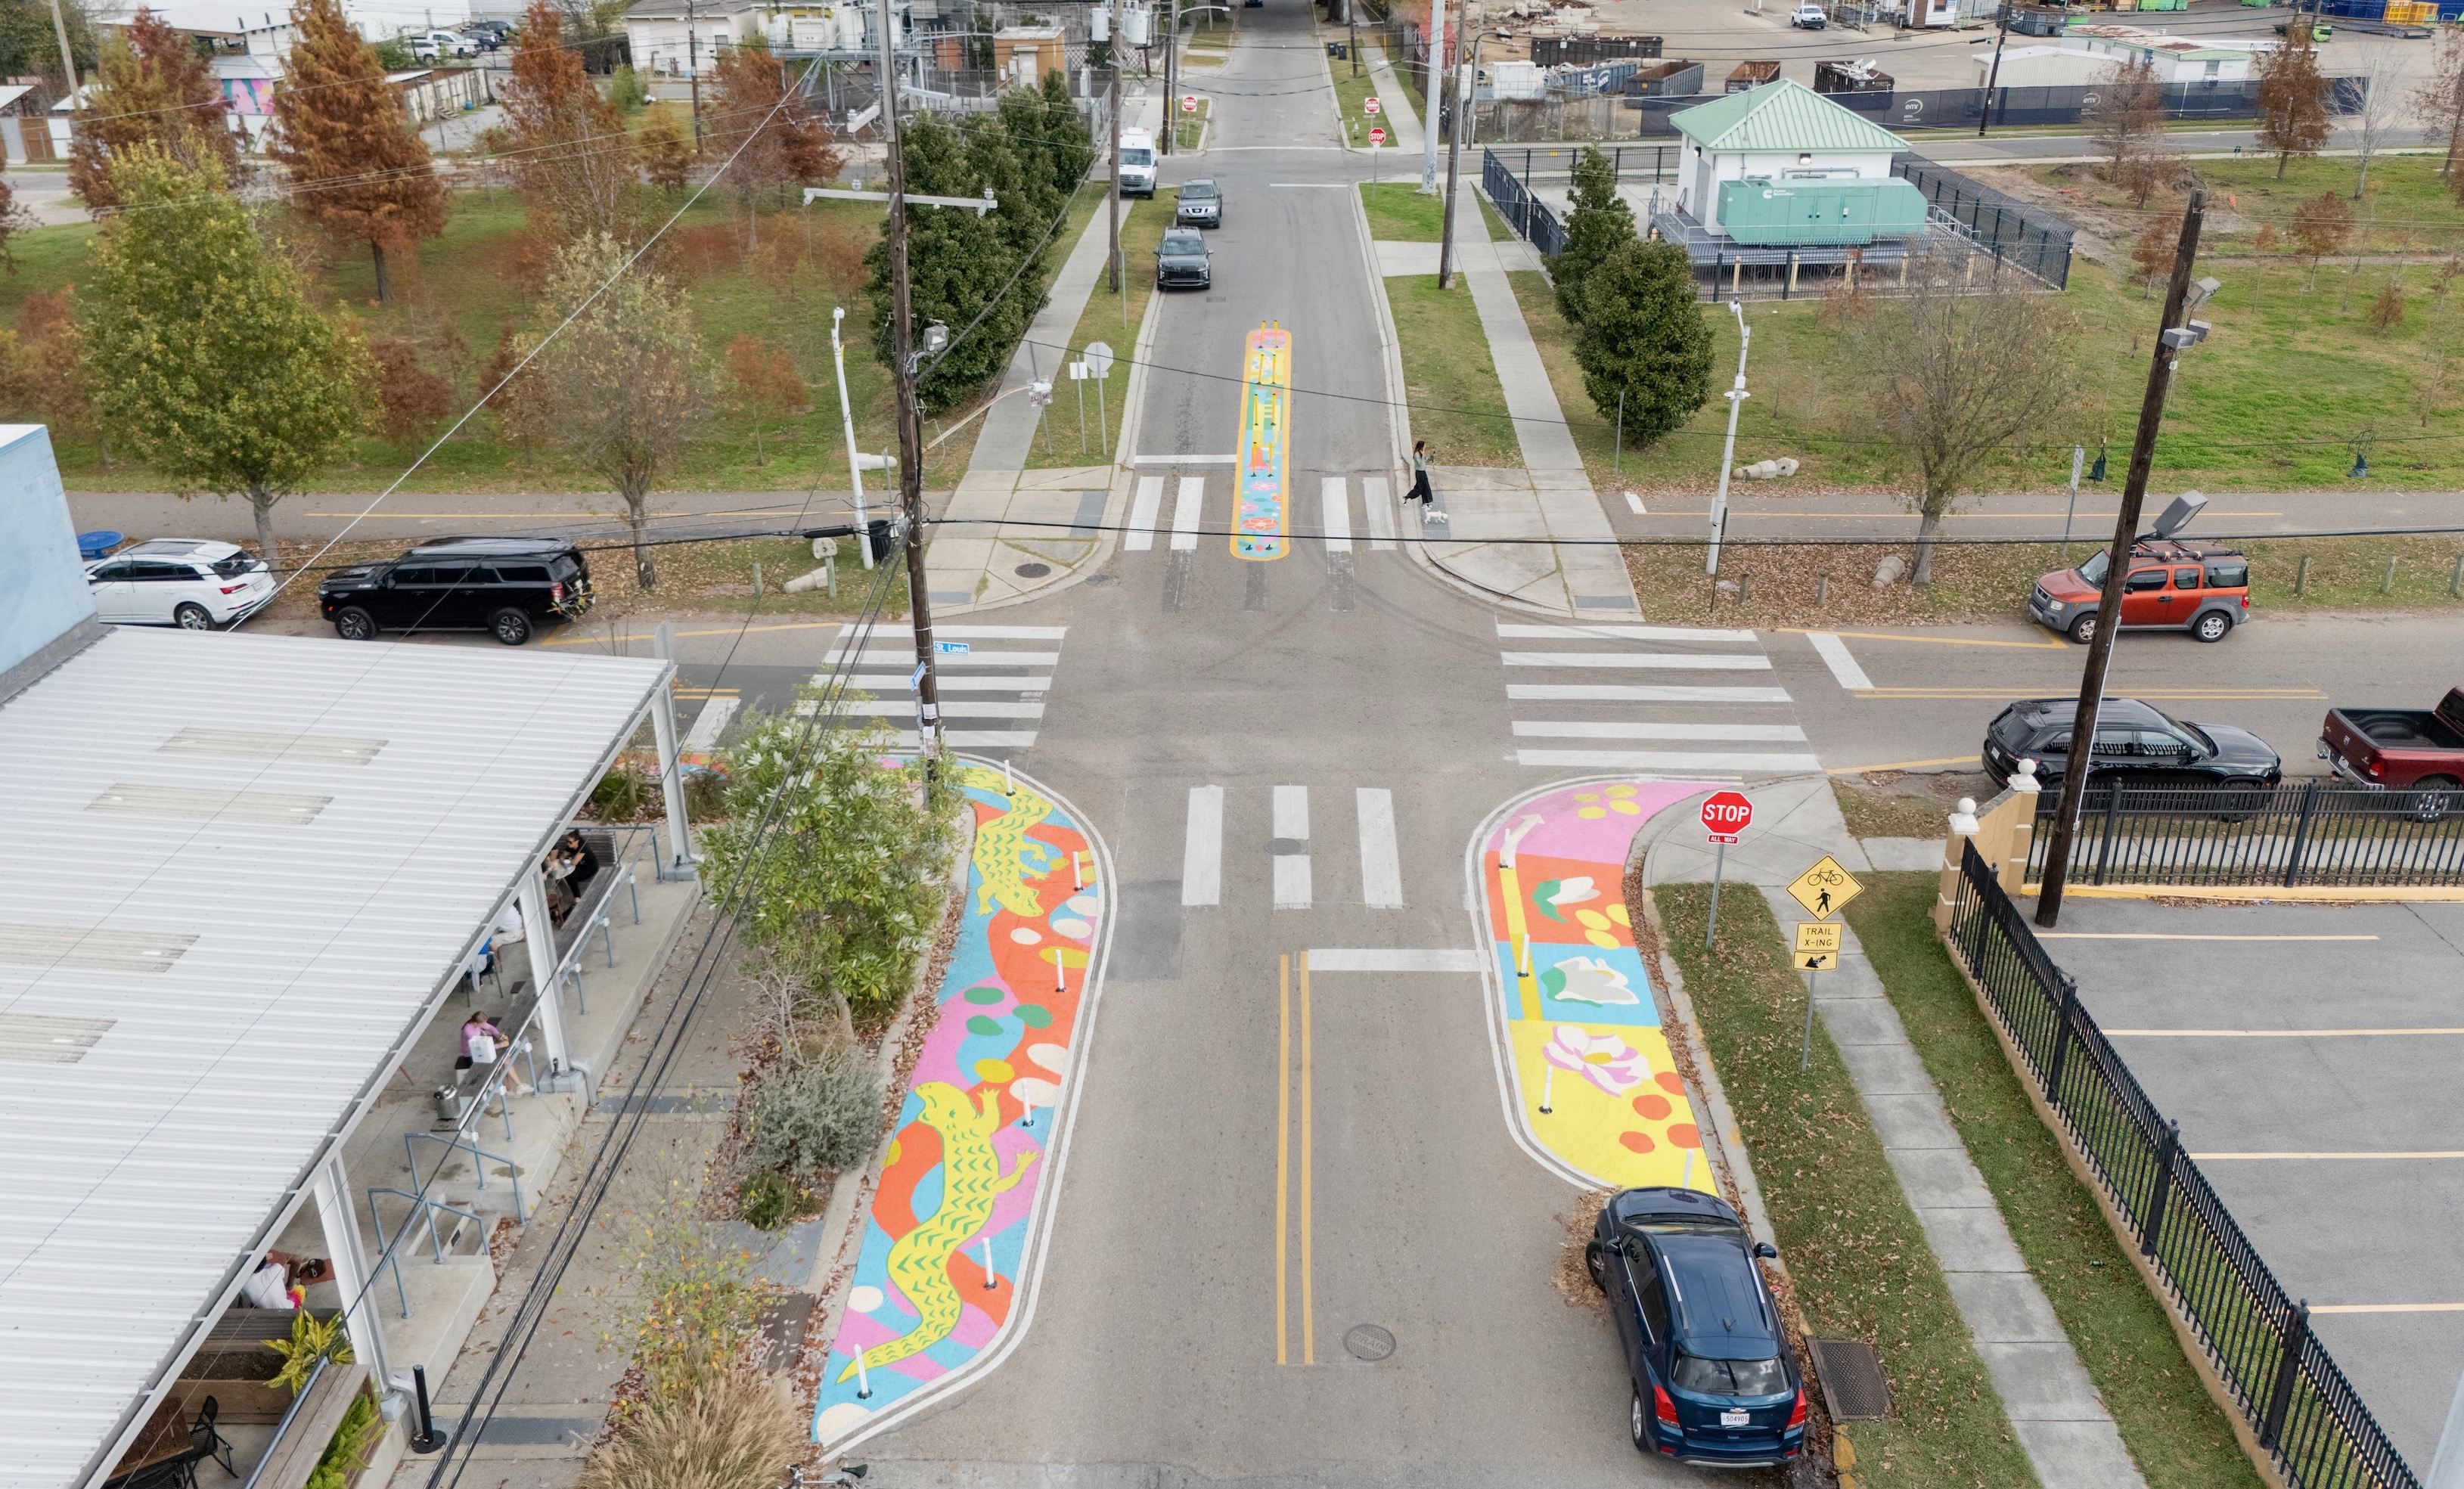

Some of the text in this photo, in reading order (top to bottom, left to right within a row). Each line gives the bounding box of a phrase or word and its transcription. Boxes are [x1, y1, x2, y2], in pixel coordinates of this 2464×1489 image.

[1370, 132, 1385, 141] STOP
[948, 644, 967, 653] Louis
[1703, 803, 1750, 823] STOP
[1806, 927, 1833, 935] TRAIL
[1804, 938, 1832, 947] X-ING
